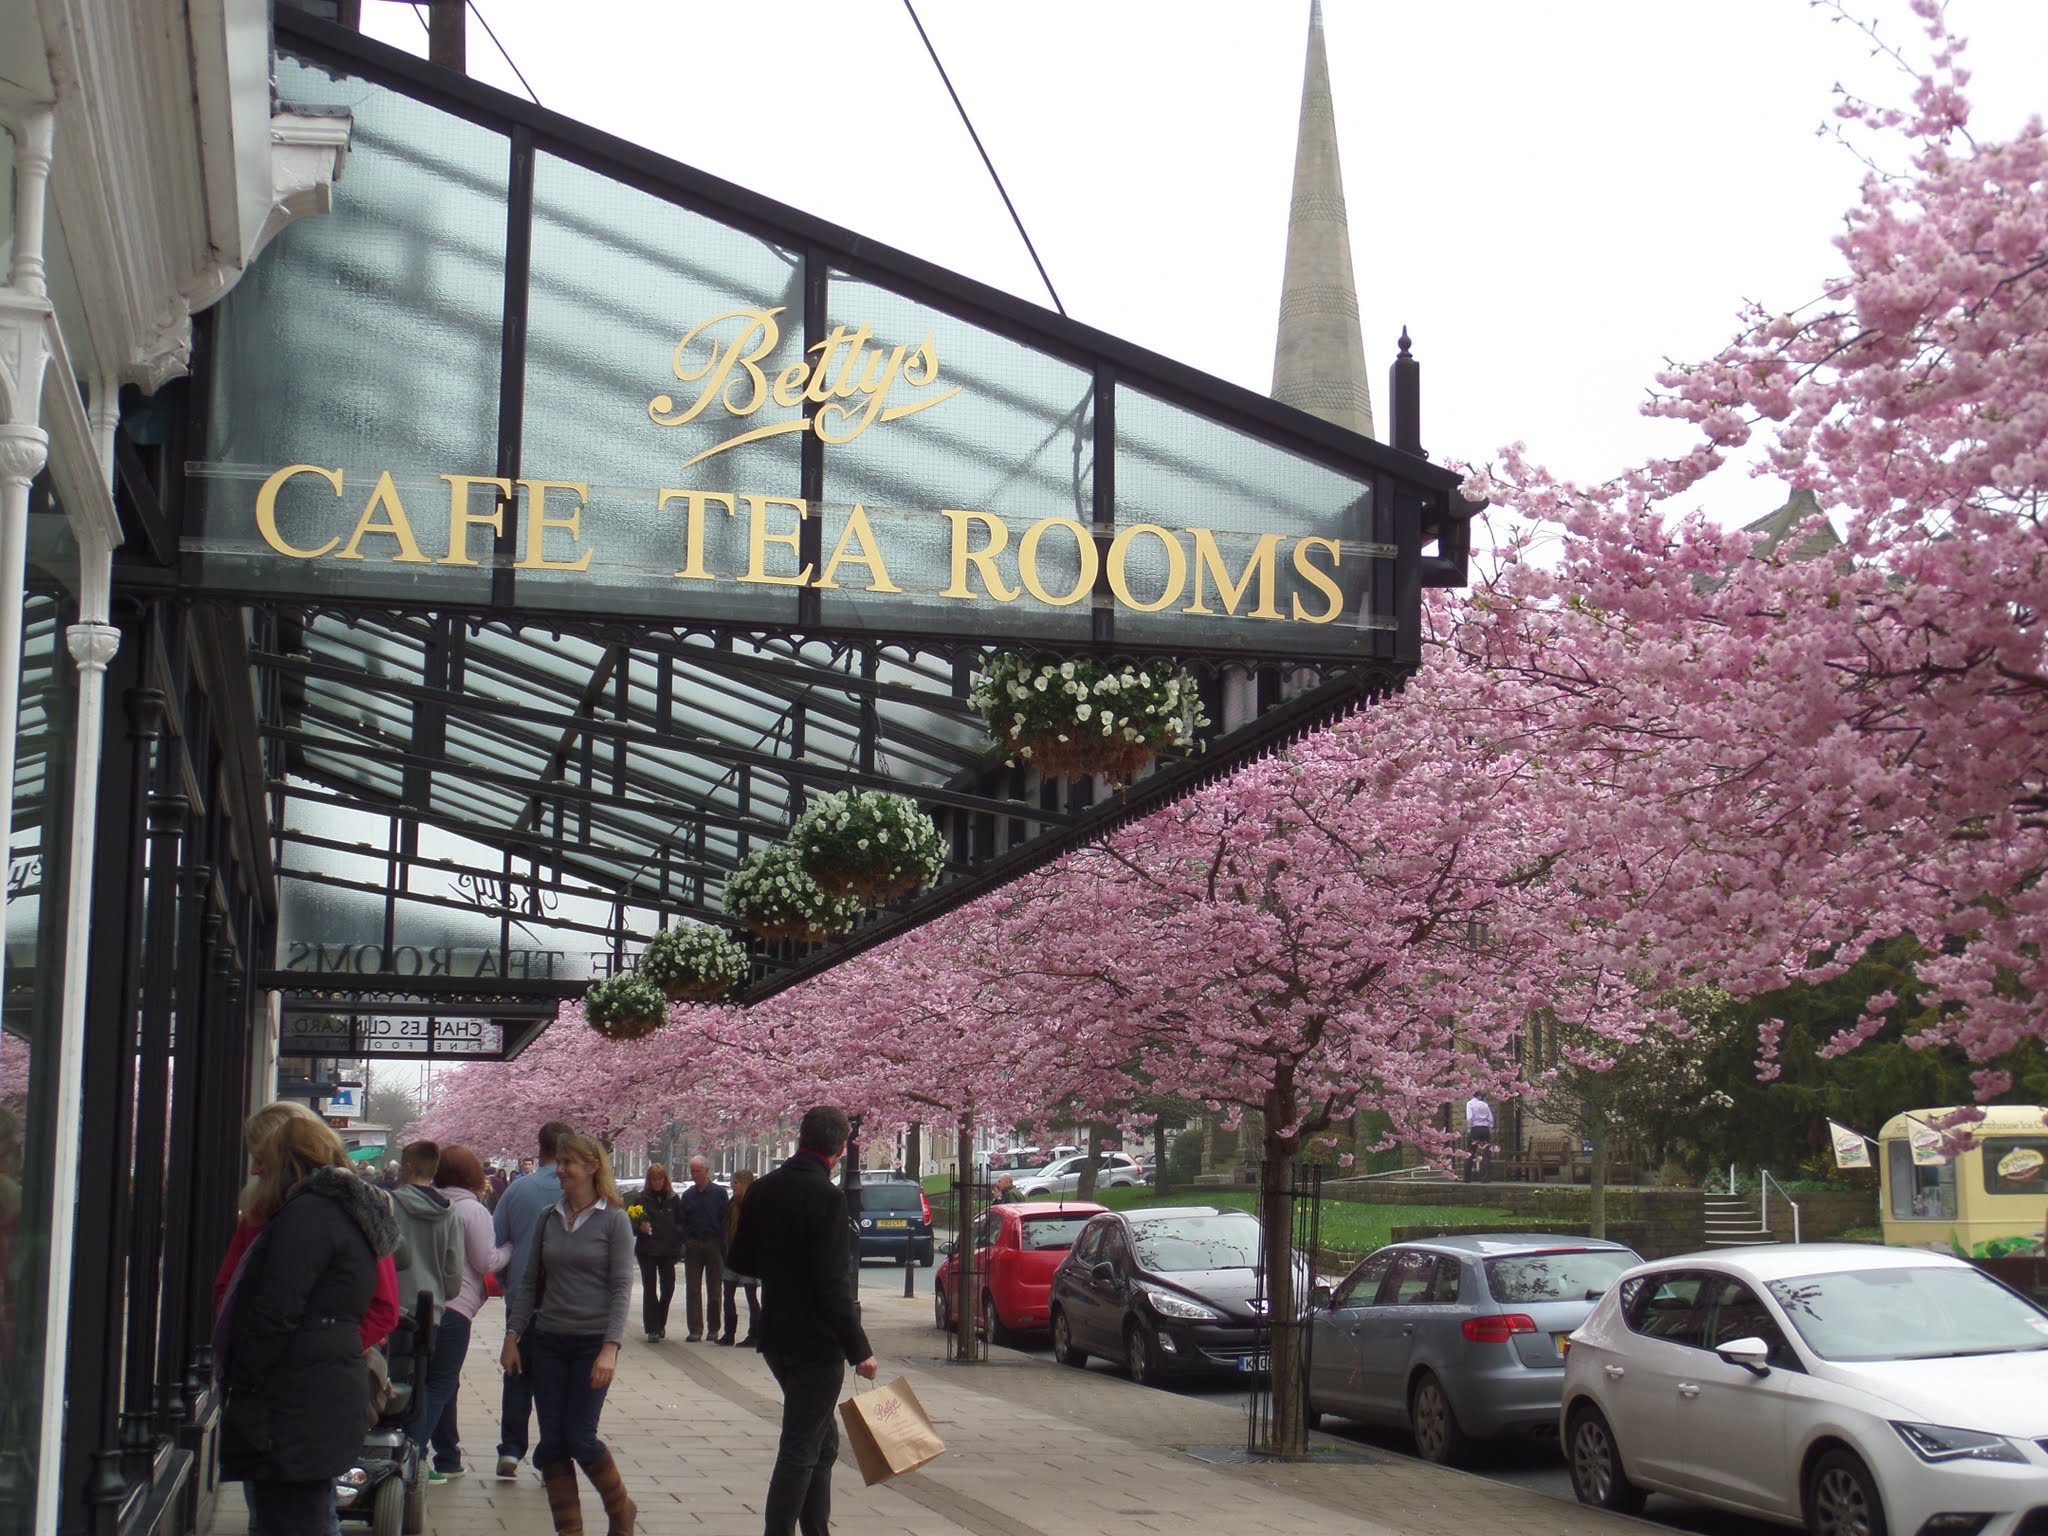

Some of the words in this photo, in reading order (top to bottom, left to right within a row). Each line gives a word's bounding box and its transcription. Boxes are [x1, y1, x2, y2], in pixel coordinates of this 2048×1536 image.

[648, 306, 963, 468] Bettys
[255, 463, 595, 572] CAFE
[657, 488, 902, 593] TEA
[939, 508, 1344, 624] ROOMS
